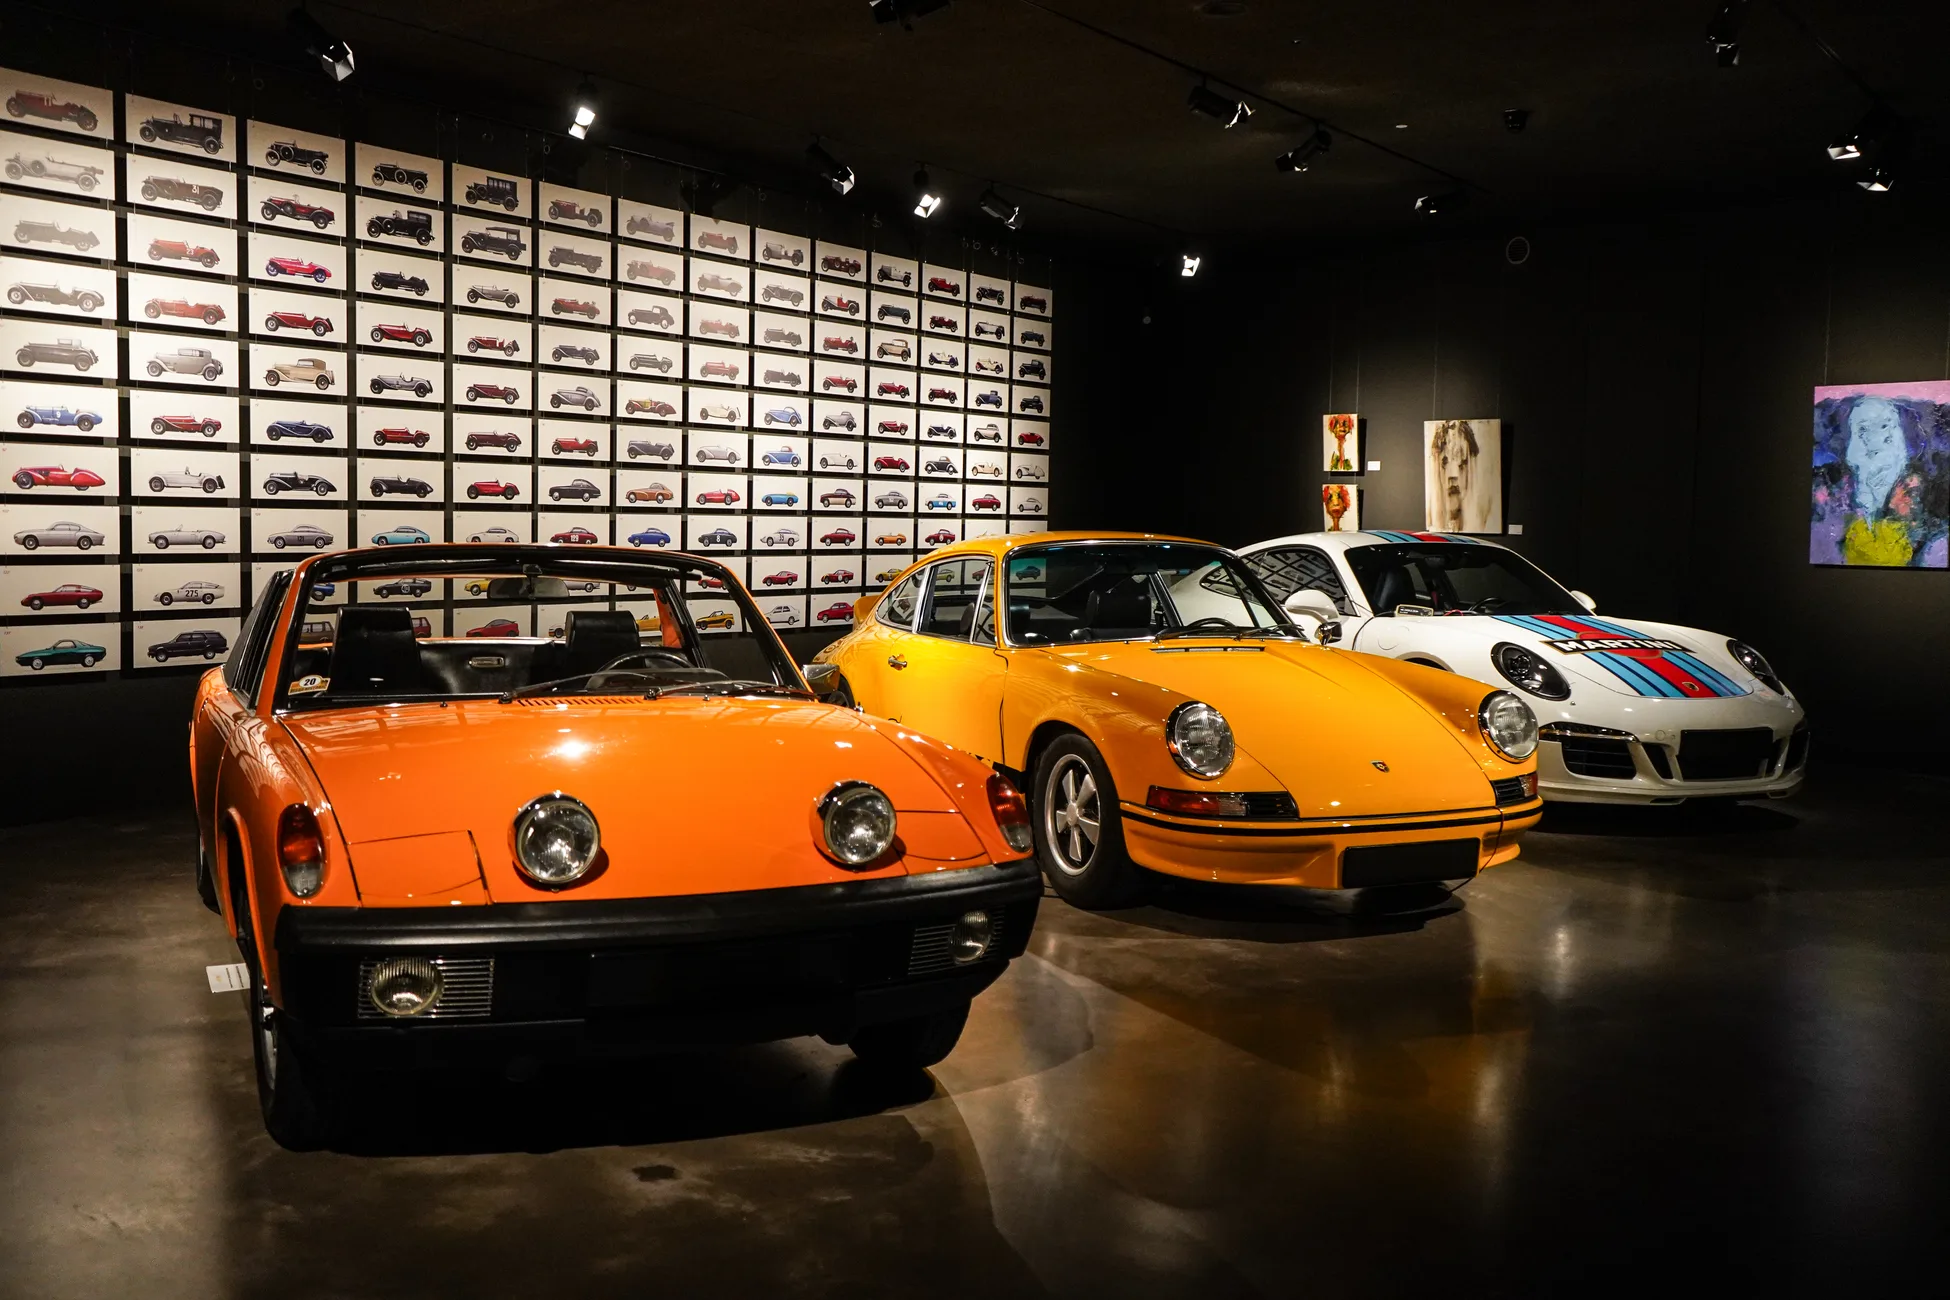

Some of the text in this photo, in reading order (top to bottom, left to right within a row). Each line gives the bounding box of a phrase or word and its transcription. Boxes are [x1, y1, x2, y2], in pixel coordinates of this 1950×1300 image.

[191, 185, 199, 194] 31
[186, 247, 194, 255] 23
[716, 535, 721, 543] 8
[185, 589, 199, 598] 275
[1553, 639, 1683, 651] MARTINI
[303, 677, 317, 687] 20
